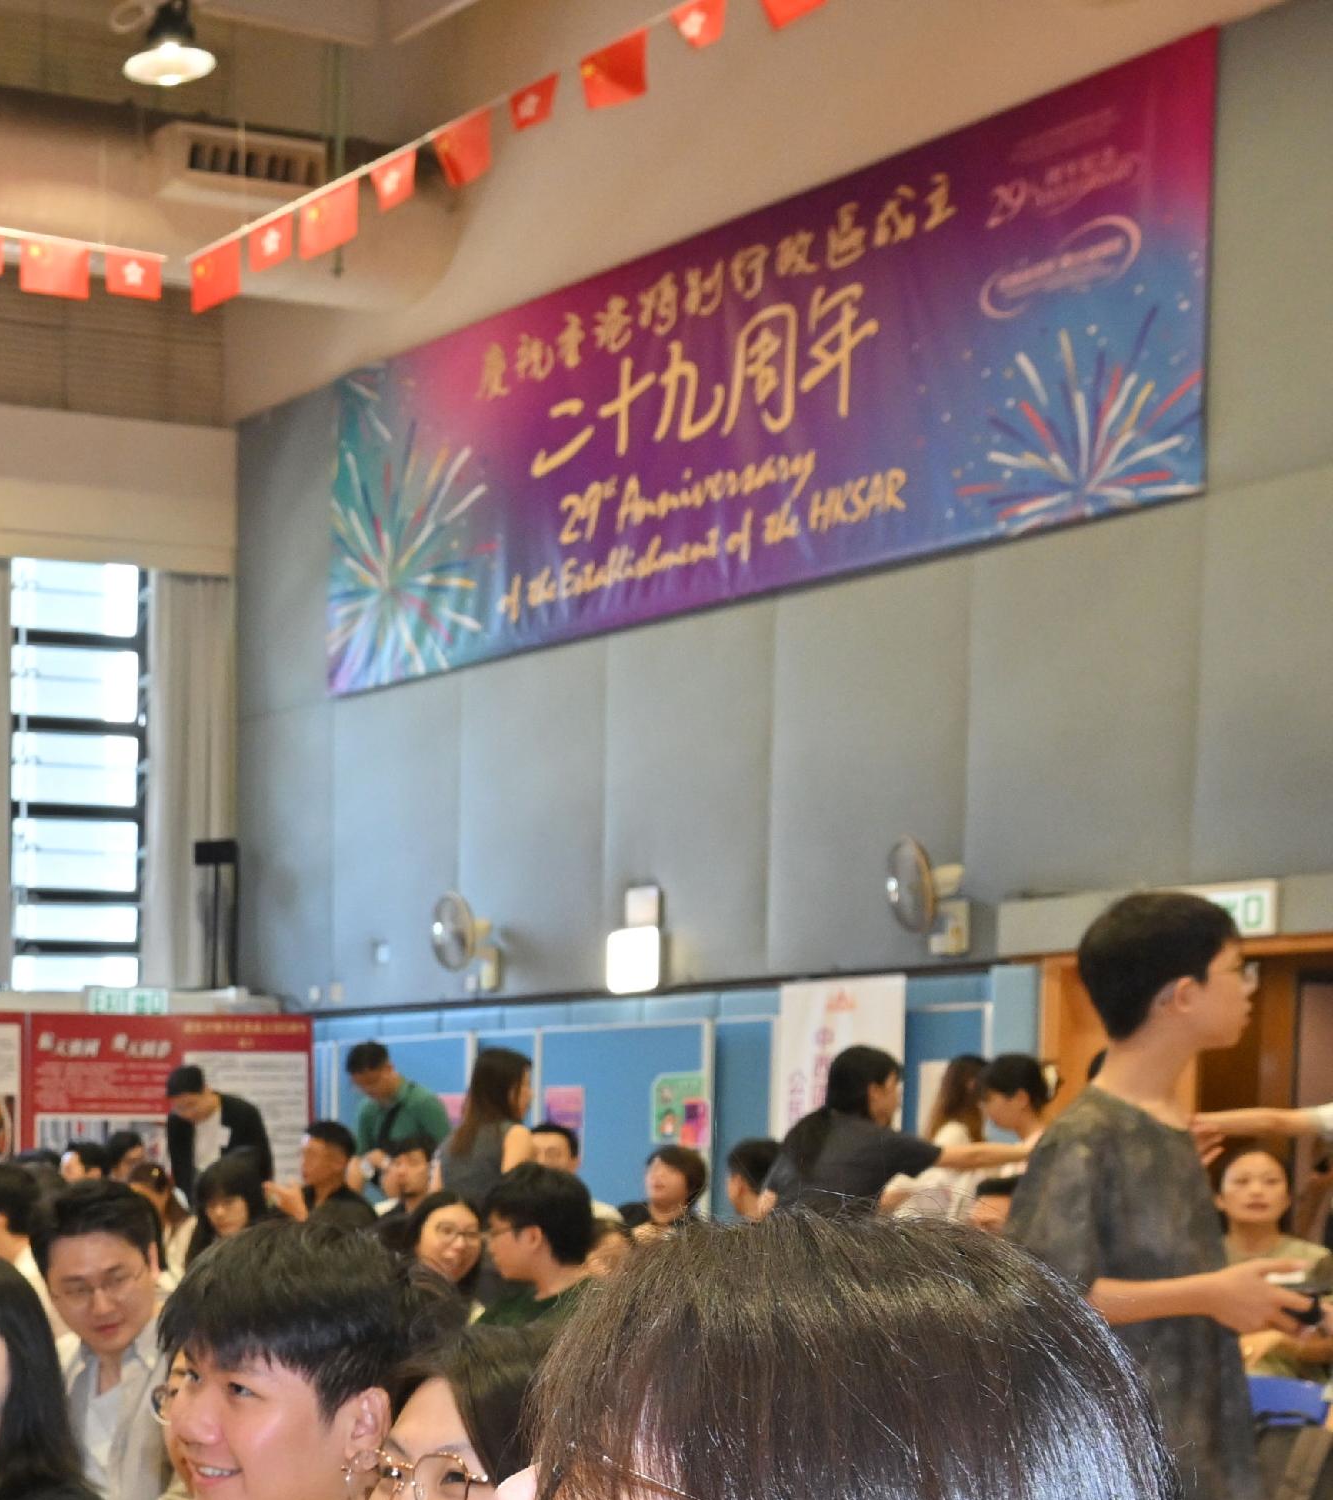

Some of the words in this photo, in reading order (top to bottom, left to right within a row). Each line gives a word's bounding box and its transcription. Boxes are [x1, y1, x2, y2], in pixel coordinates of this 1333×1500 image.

[530, 282, 880, 478] 二十九周年
[497, 574, 522, 623] of
[527, 565, 558, 607] the
[559, 525, 722, 600] Establishment
[725, 508, 754, 563] of
[763, 503, 801, 546] the
[807, 467, 908, 533] HKSAR
[616, 450, 816, 532] Anniversary
